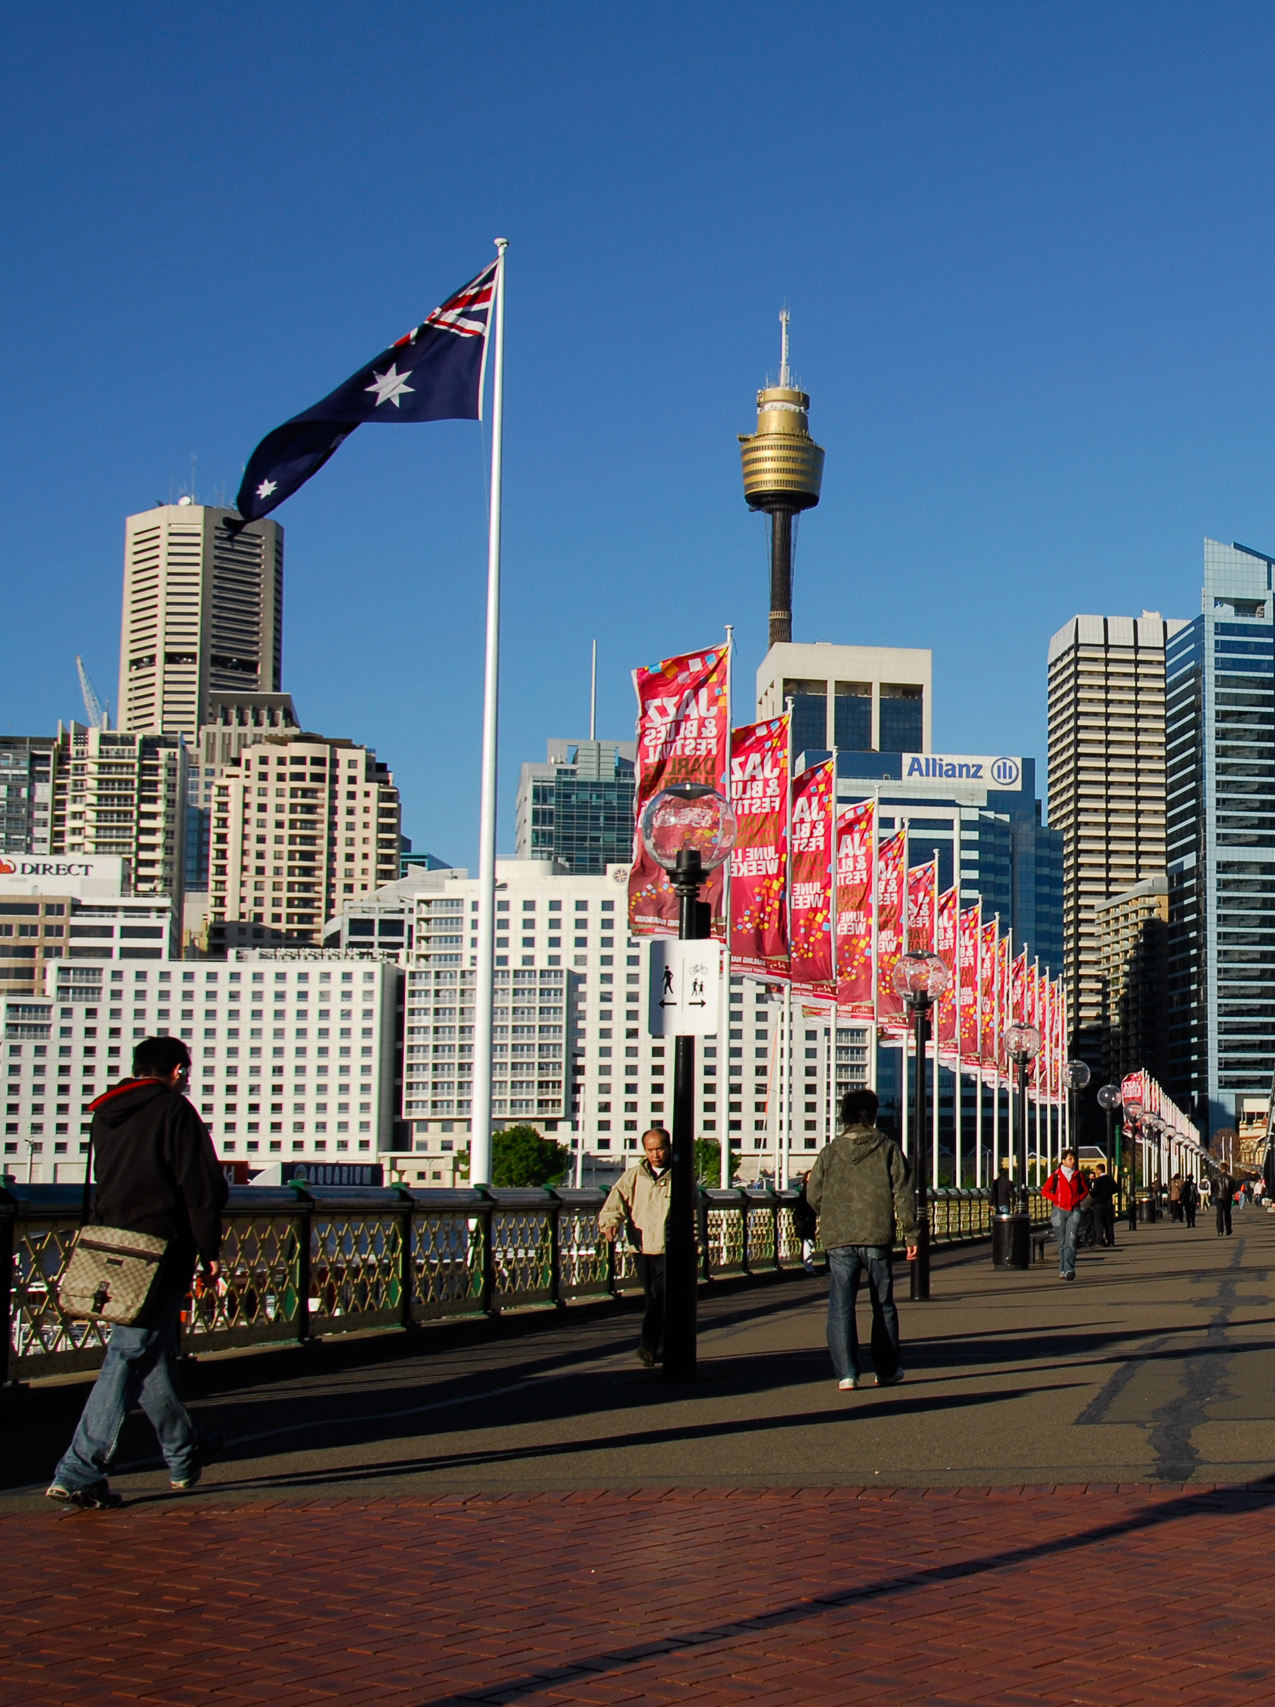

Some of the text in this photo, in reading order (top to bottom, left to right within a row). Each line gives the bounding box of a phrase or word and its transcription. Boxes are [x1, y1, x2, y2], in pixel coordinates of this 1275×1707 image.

[907, 757, 983, 779] Allianz
[20, 863, 94, 876] DIRECT
[309, 1166, 372, 1185] AQUARIUM
